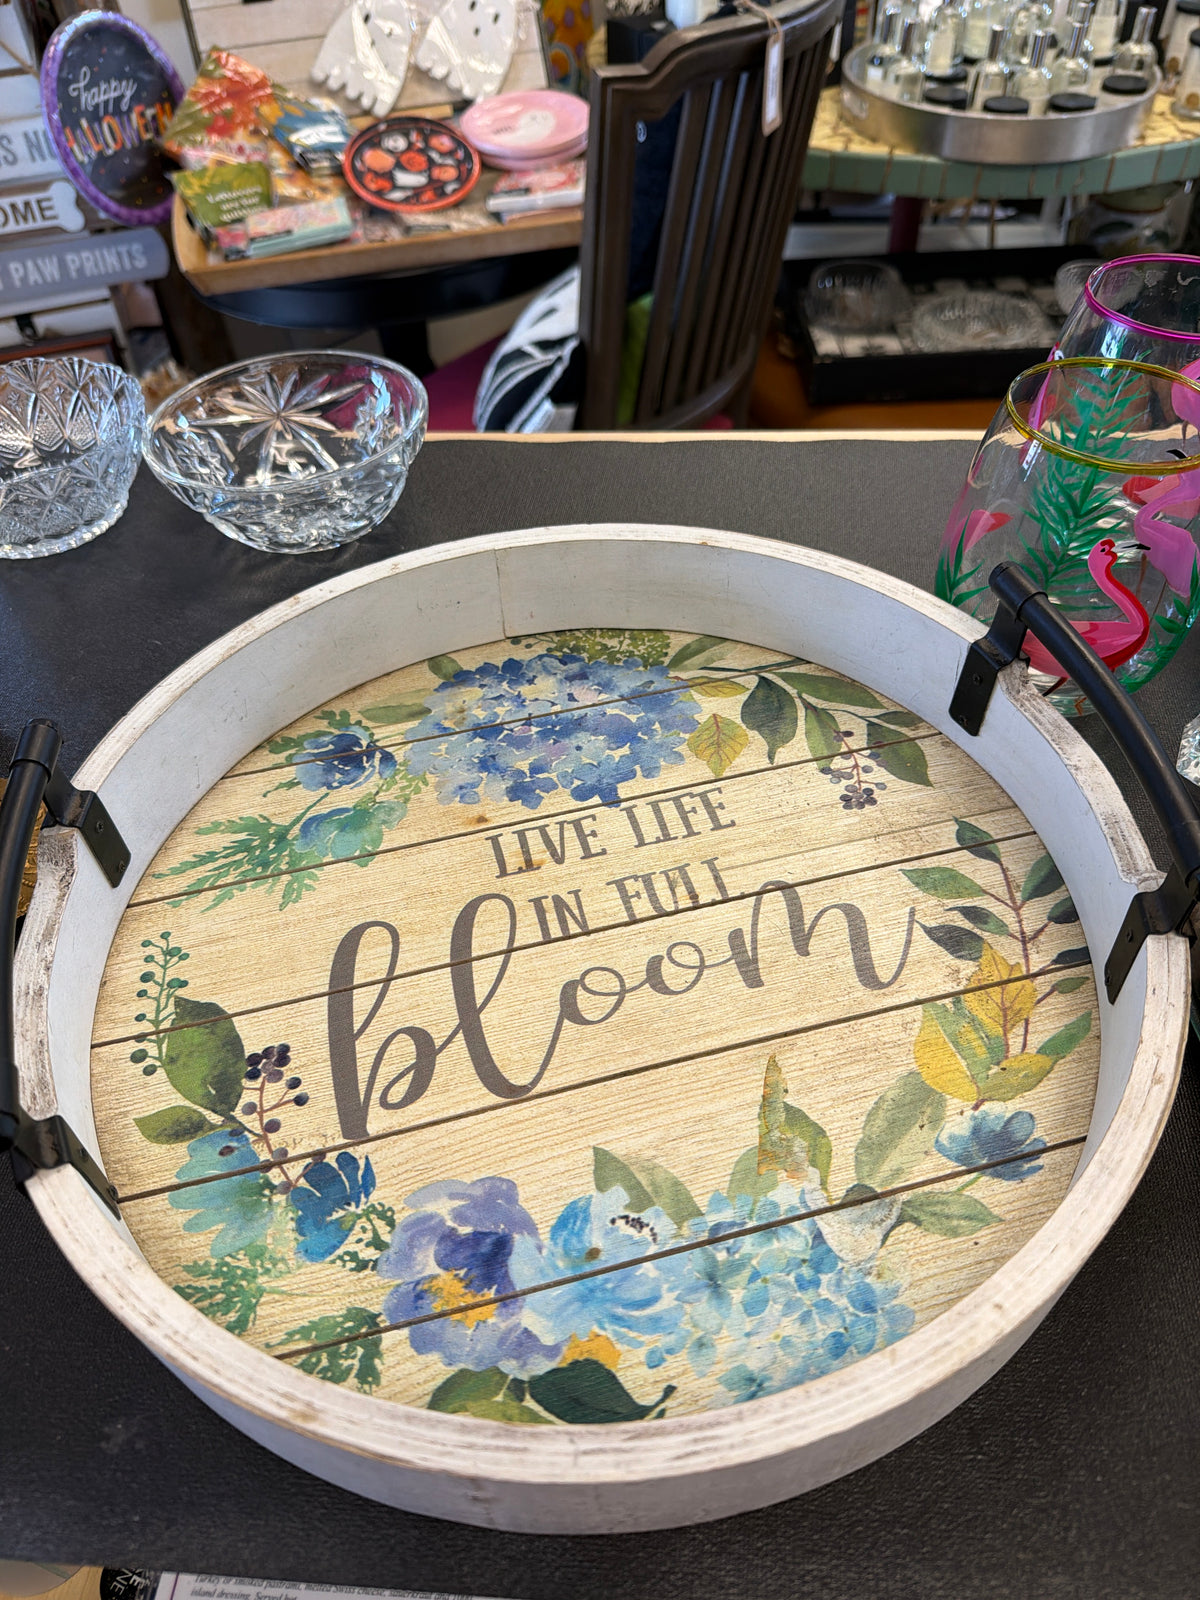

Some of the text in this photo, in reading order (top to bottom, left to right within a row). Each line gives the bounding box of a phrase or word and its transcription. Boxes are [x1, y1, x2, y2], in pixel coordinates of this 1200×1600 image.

[68, 65, 138, 117] happy
[9, 243, 148, 288] PAW PRINTS
[485, 786, 736, 880] LIVE LIFE
[528, 856, 746, 942] IN FULL
[326, 879, 916, 1141] bloom
